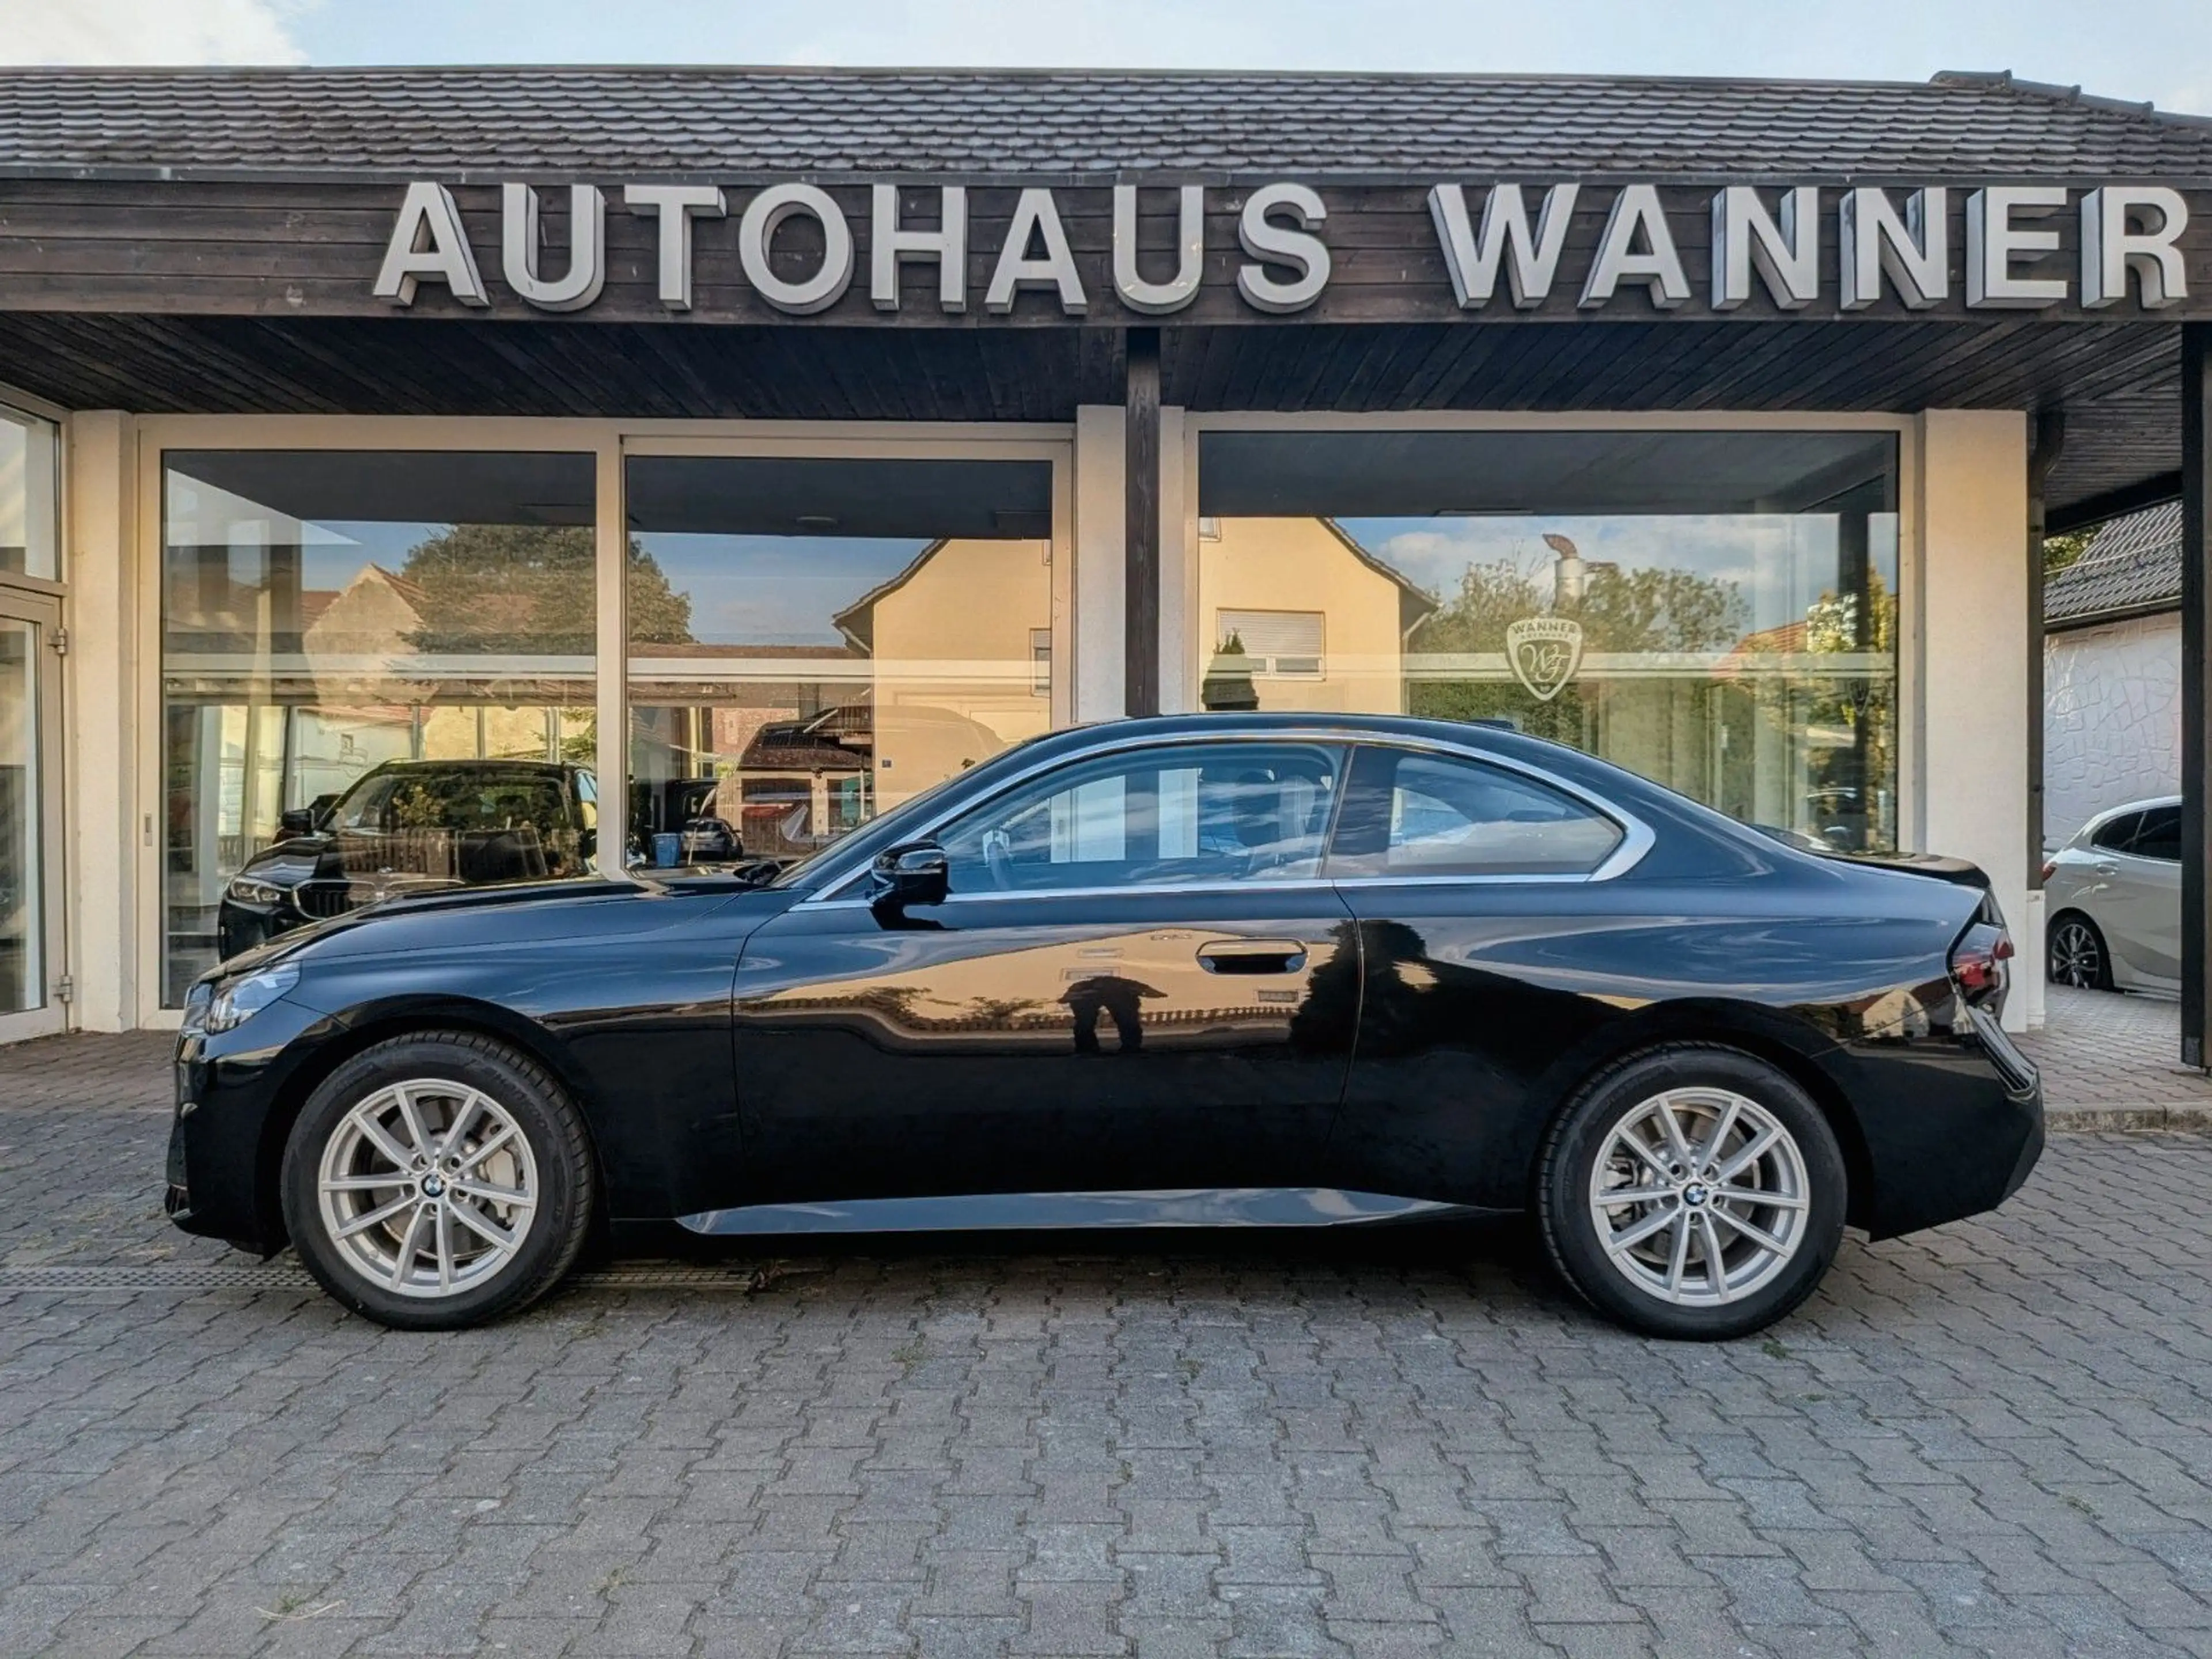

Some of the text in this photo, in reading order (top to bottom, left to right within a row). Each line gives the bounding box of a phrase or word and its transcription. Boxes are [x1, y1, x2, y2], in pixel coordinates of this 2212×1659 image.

[373, 181, 2189, 316] AUTOHAUS WANNER
[1512, 621, 1577, 634] WANNER
